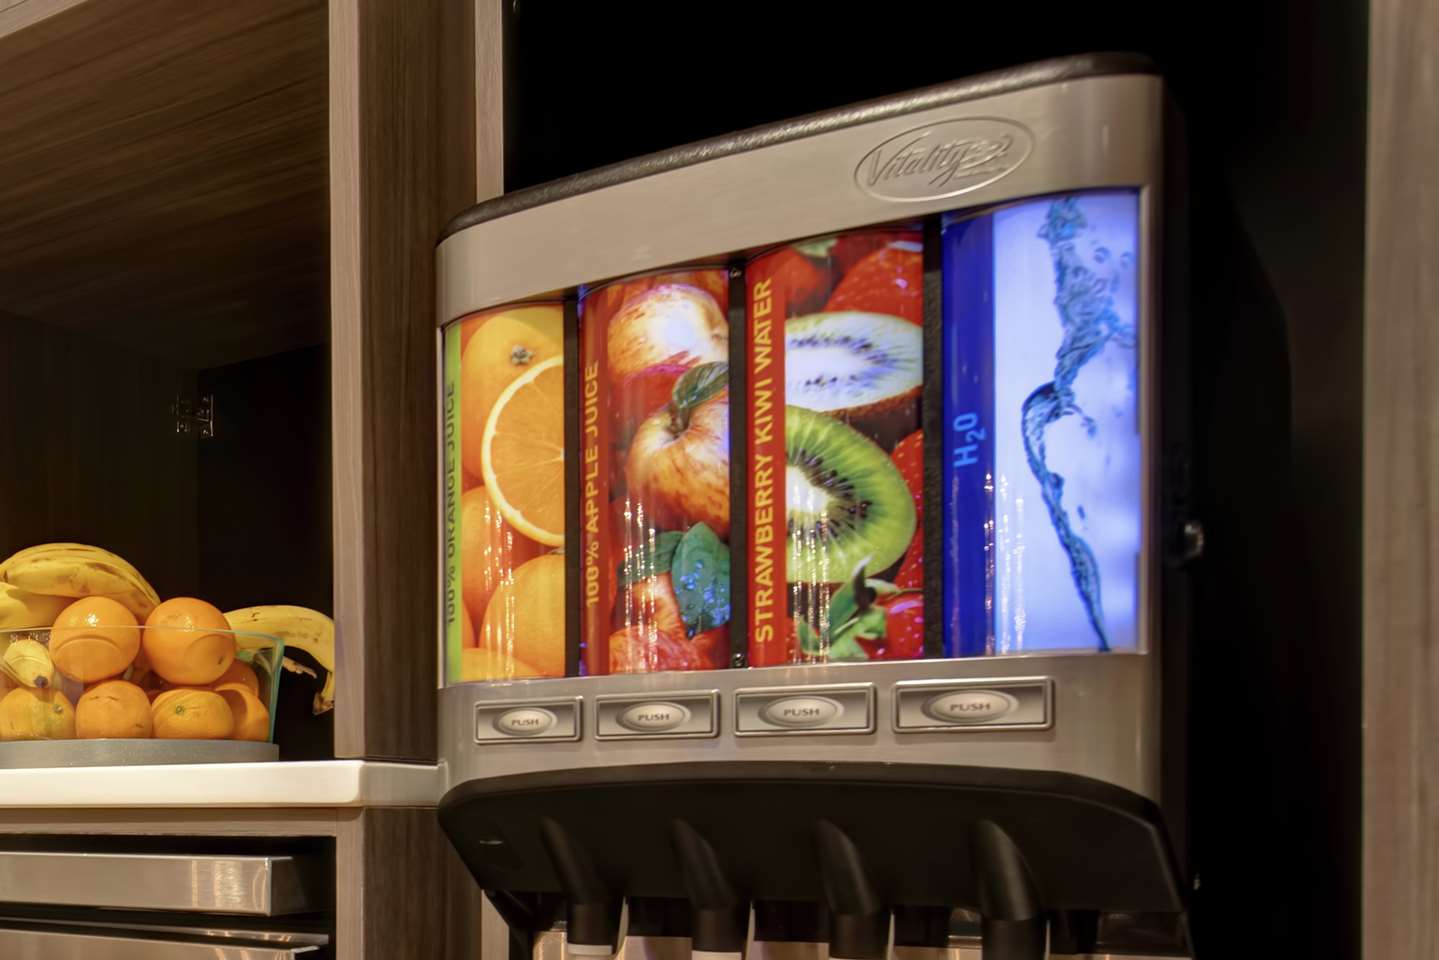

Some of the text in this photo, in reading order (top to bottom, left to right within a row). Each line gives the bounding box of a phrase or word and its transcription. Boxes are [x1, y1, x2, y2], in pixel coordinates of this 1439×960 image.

[868, 131, 972, 187] Vitality
[447, 382, 456, 451] JUICE
[584, 360, 600, 609] 100% APPLE JUICE
[754, 278, 773, 642] STRAWBERRY KIWI WATER
[447, 458, 456, 558] ORANGE
[511, 718, 540, 727] PUSH
[637, 713, 670, 722] PUSH
[783, 708, 820, 717] PUSH
[949, 702, 991, 712] PUSH
